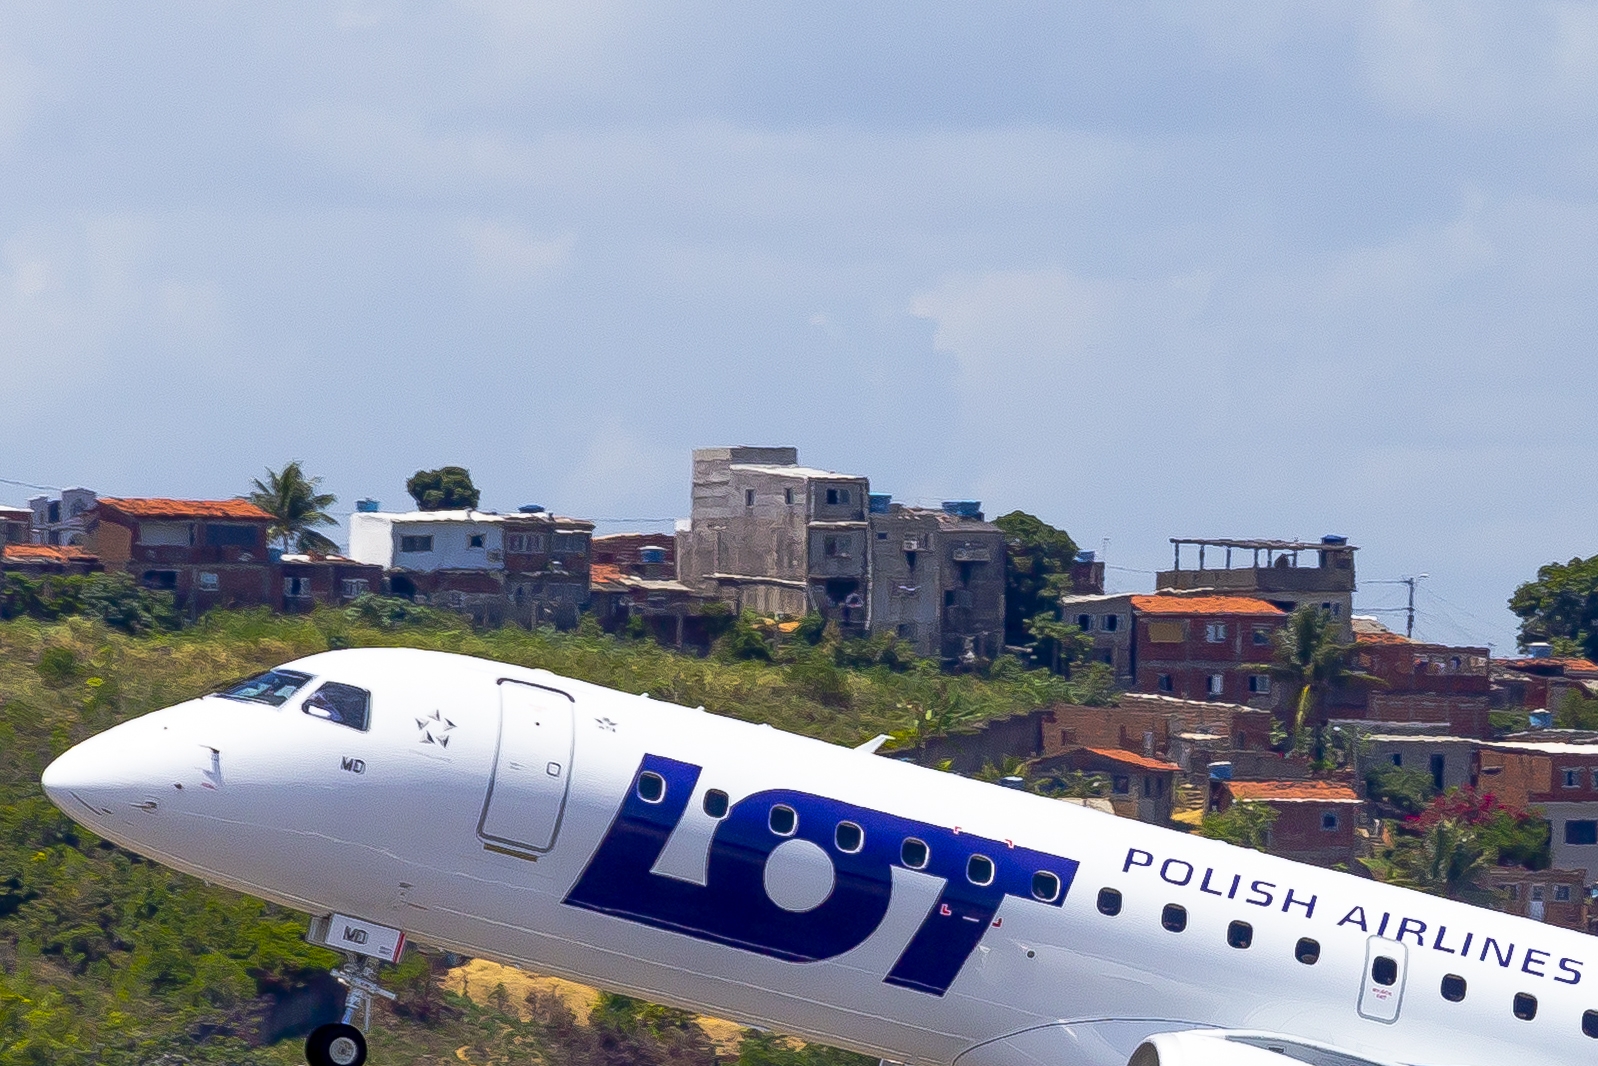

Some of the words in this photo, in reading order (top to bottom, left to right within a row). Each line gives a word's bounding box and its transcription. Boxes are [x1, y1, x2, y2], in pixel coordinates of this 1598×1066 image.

[340, 755, 366, 775] MD
[561, 753, 1081, 997] LOT
[1122, 848, 1318, 919] POLISH
[1336, 905, 1585, 986] AIRLINES
